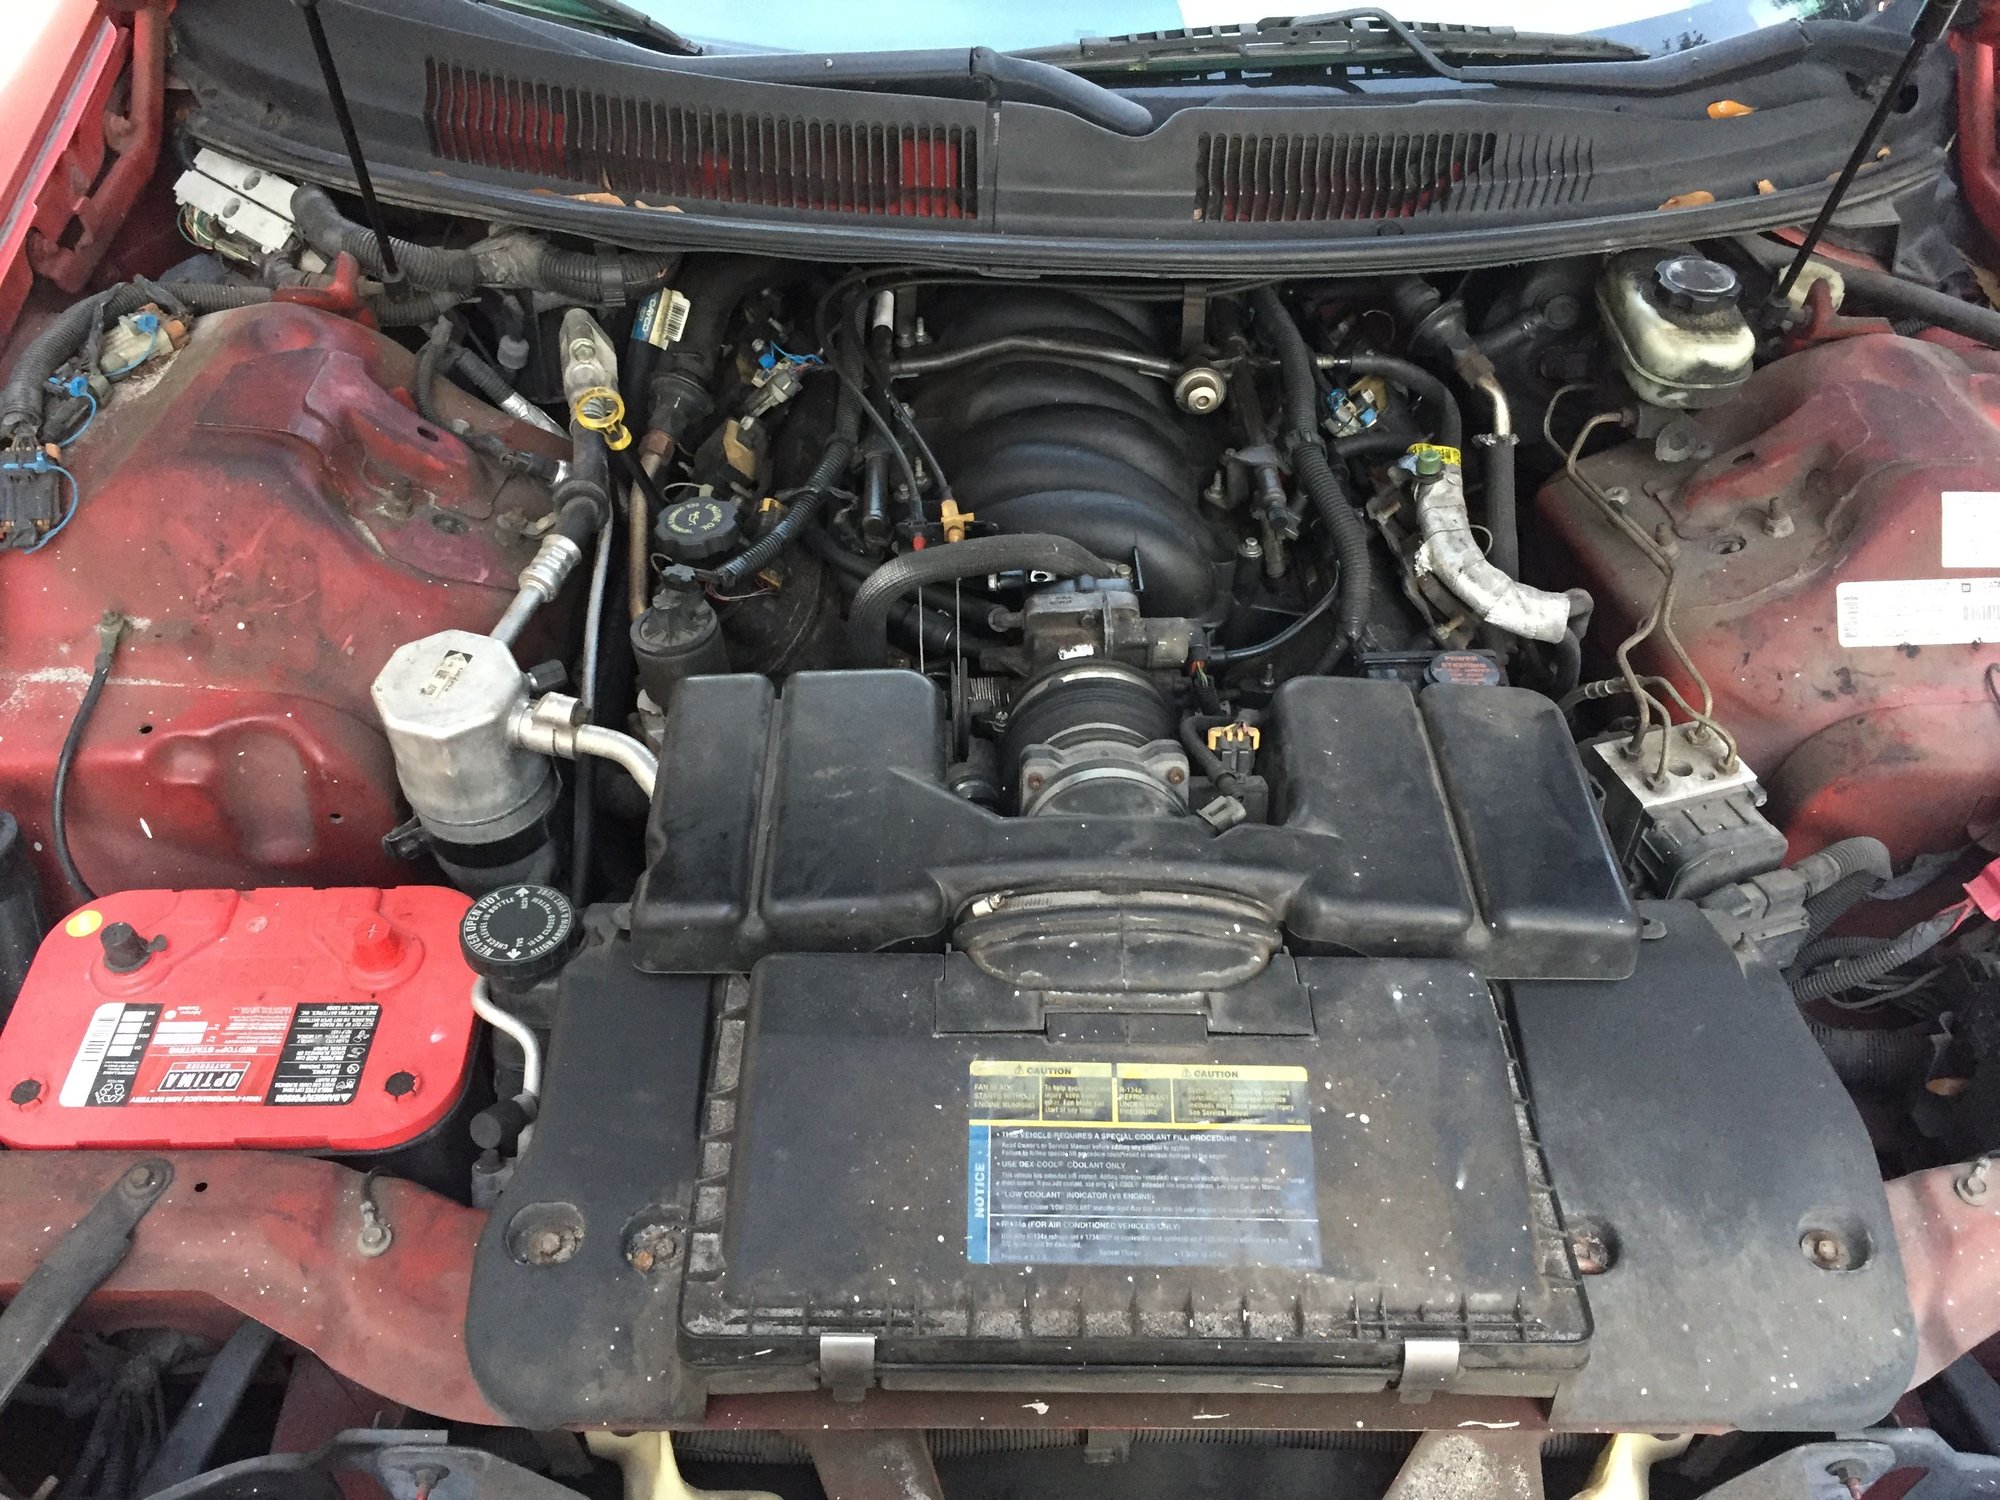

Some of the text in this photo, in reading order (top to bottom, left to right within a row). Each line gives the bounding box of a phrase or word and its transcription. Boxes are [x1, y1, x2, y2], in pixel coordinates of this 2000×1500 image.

[642, 298, 657, 332] DAYCO
[700, 503, 722, 531] ENGINE OIL
[465, 892, 501, 957] NEVER OPEN HOT
[480, 897, 515, 950] CHECK LEVEL IN BOTTLE
[534, 934, 544, 942] LB
[542, 914, 556, 936] CLOSED
[530, 940, 554, 956] ALIGN
[552, 918, 568, 941] ARROW
[168, 1046, 215, 1054] STARTING
[1026, 1067, 1072, 1075] CAUTION
[168, 1073, 240, 1088] OPTIMA
[974, 1083, 988, 1091] FAN
[275, 1094, 340, 1102] DANGER/POISON
[1002, 1101, 1036, 1109] RUNNING
[1053, 1132, 1093, 1140] REQUIRES
[1134, 1133, 1171, 1141] COOLANT
[1190, 1134, 1237, 1142] PROCEDURE
[1067, 1160, 1104, 1168] COOLANT
[1105, 1162, 1126, 1170] ONLY
[974, 1163, 985, 1219] NOTICE
[1066, 1191, 1108, 1200] INDICATOR
[1123, 1192, 1155, 1201] ENGINE)
[1027, 1221, 1047, 1229] (FOR
[1063, 1221, 1116, 1229] CONDITIONED
[1118, 1222, 1156, 1230] VEHICLES
